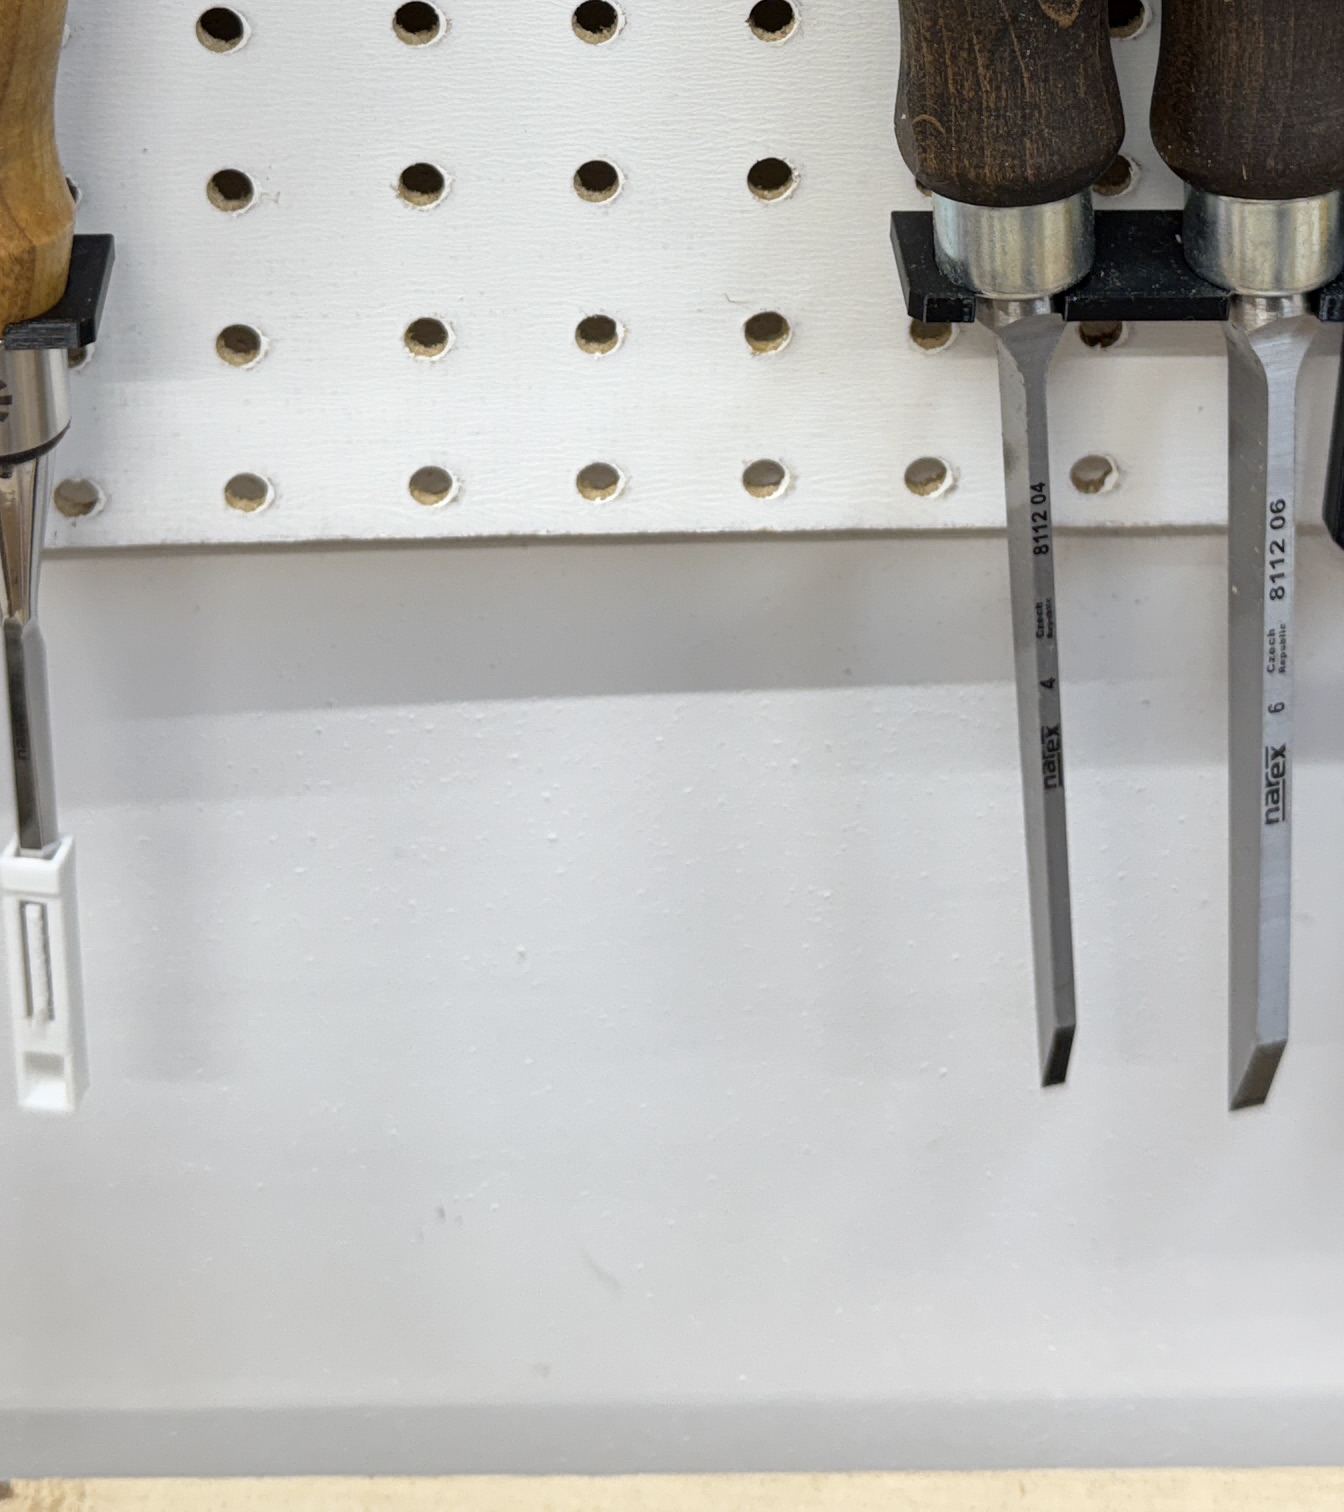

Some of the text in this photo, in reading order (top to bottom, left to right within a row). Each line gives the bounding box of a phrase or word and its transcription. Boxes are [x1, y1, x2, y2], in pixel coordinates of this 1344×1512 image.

[1031, 482, 1049, 557] 8112 04
[1269, 498, 1287, 601] 8112 06
[1040, 677, 1063, 789] narex 4
[1265, 701, 1287, 825] narex 6
